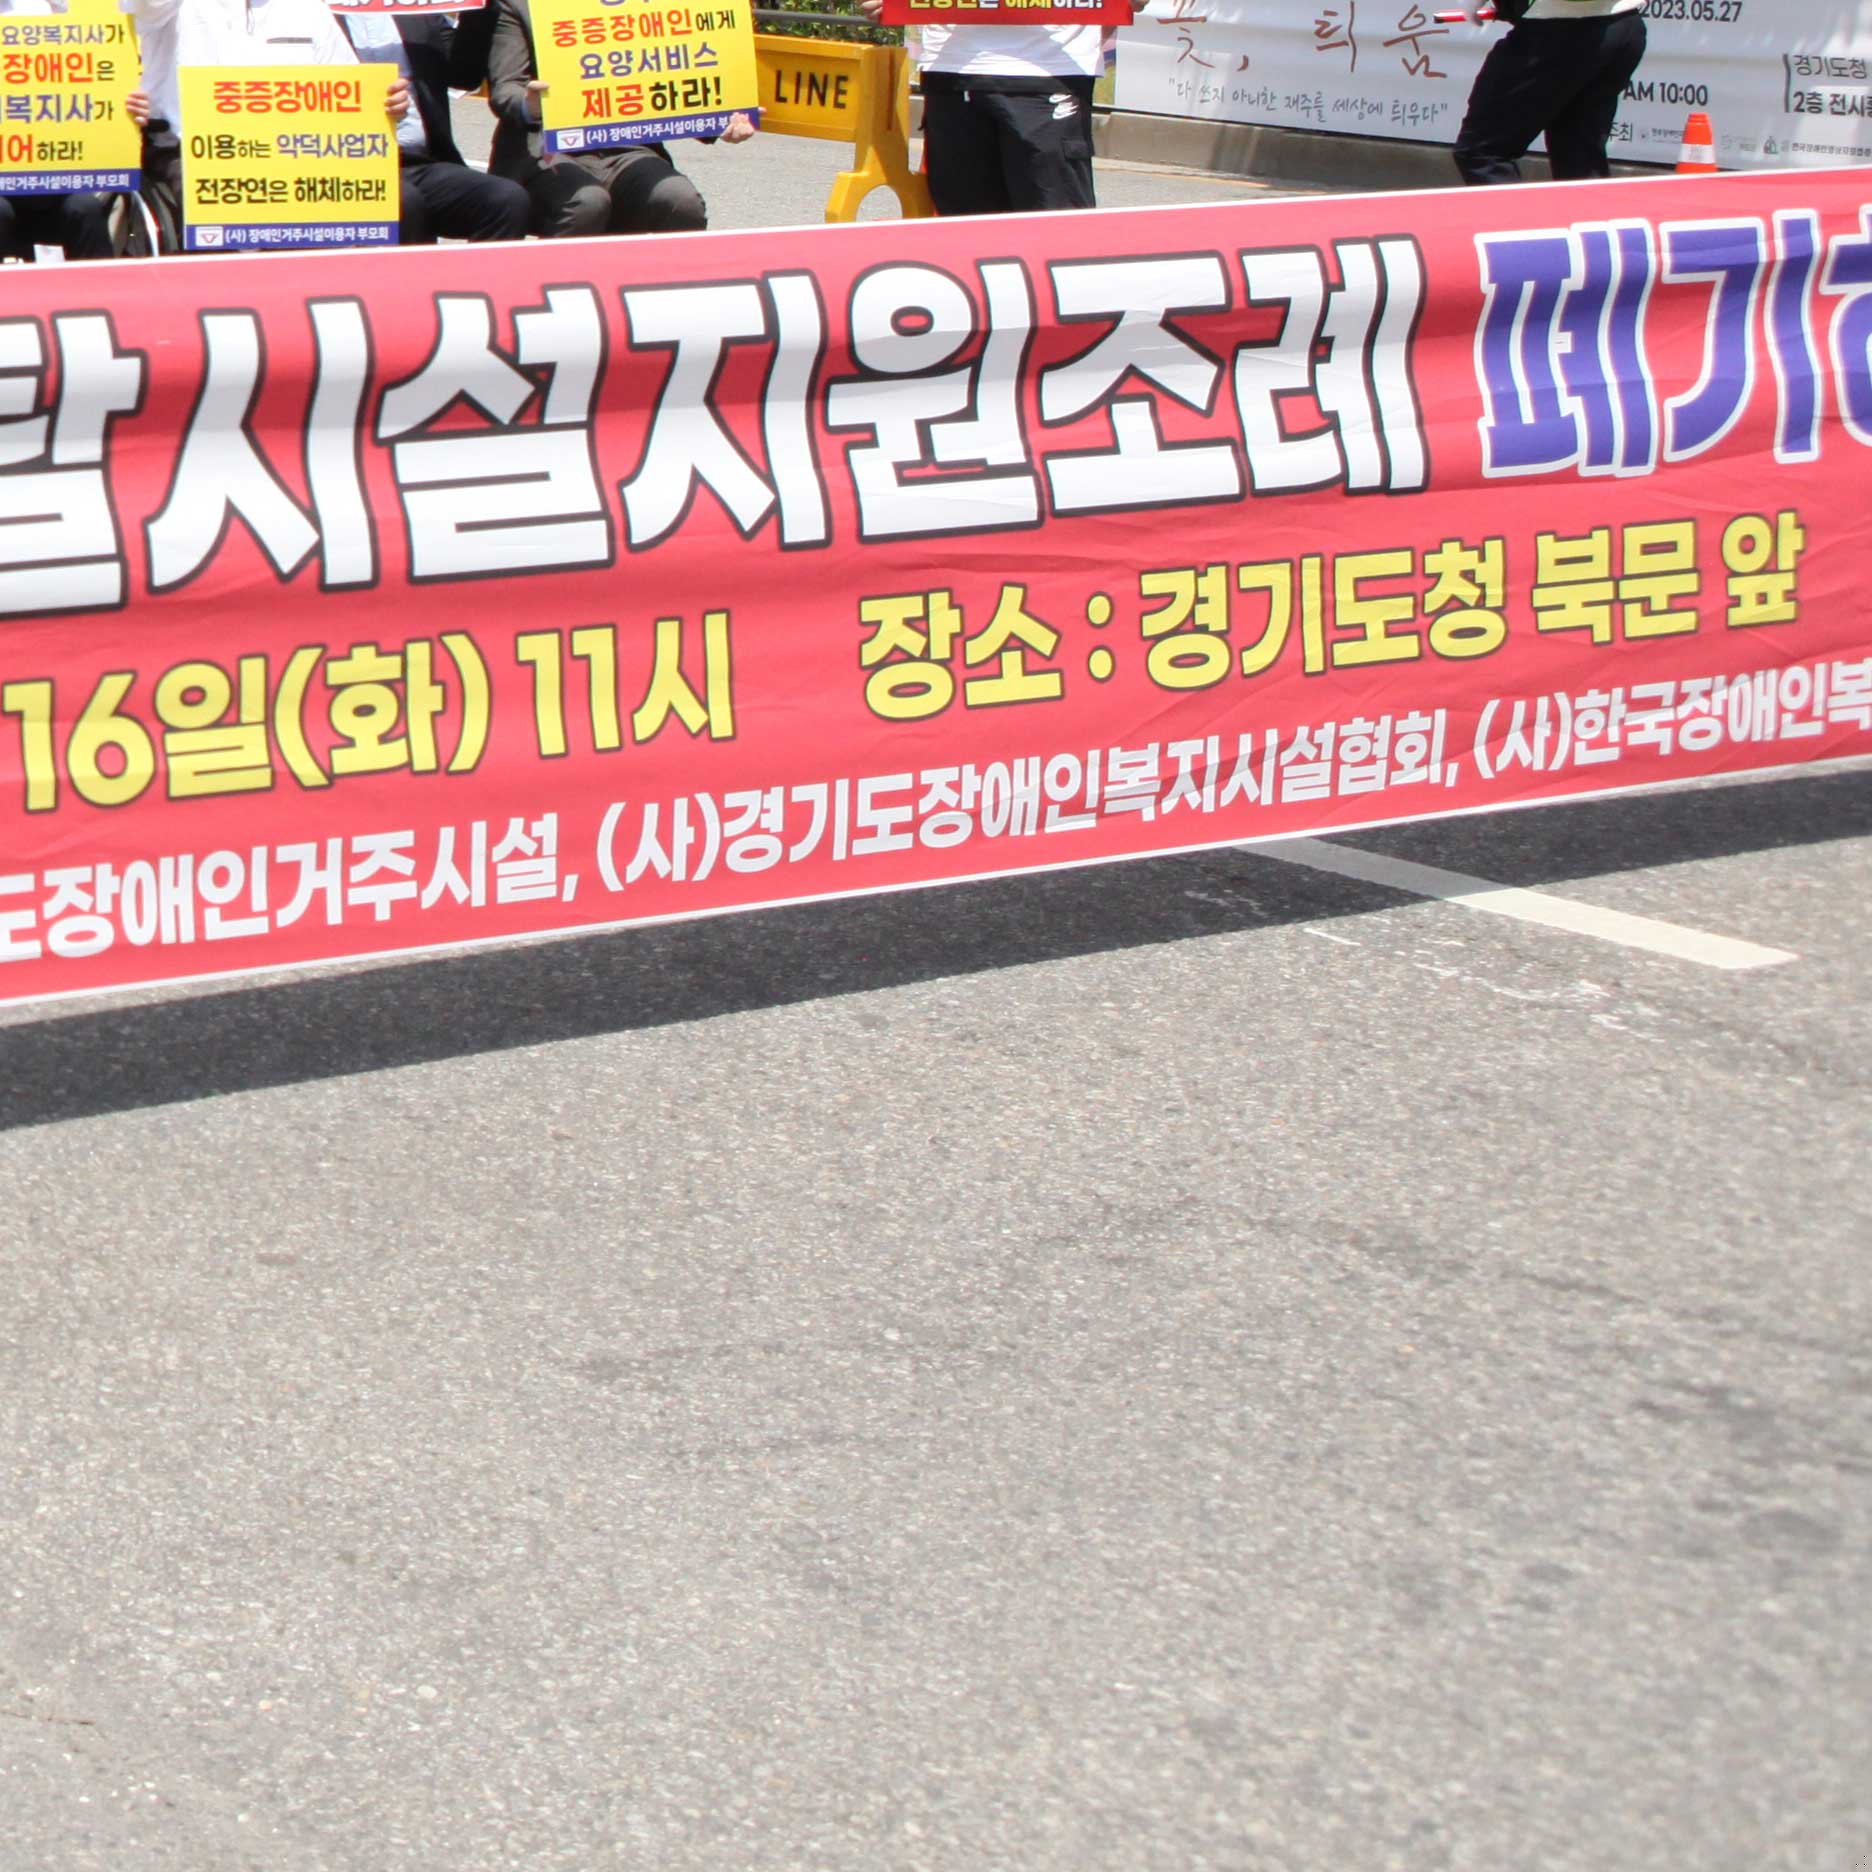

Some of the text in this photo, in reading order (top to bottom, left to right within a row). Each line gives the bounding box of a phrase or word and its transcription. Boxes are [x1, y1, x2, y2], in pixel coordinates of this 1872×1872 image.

[552, 8, 736, 48] 중증장애인에게
[579, 42, 718, 80] 요양서비스
[1794, 55, 1868, 81] 경기도청
[213, 80, 362, 114] 중증장애인
[582, 76, 722, 120] 제공하라!
[774, 69, 849, 111] LINE
[1198, 84, 1225, 103] 쓰지
[1232, 88, 1277, 109] 아니한
[1284, 92, 1327, 122] 재주를
[1333, 99, 1383, 120] 세상에
[1659, 83, 1708, 106] 10:00
[1793, 91, 1823, 114] 2층
[191, 133, 389, 162] 이용하는 악덕사업자
[195, 176, 387, 205] 전장연은 해체하라!
[1, 631, 493, 810] 16일(화)
[516, 608, 736, 760] 11시
[857, 581, 1065, 723] 장소
[1137, 537, 1508, 694] 경기도청
[1533, 521, 1700, 646] 북문
[1723, 509, 1806, 630] 앞
